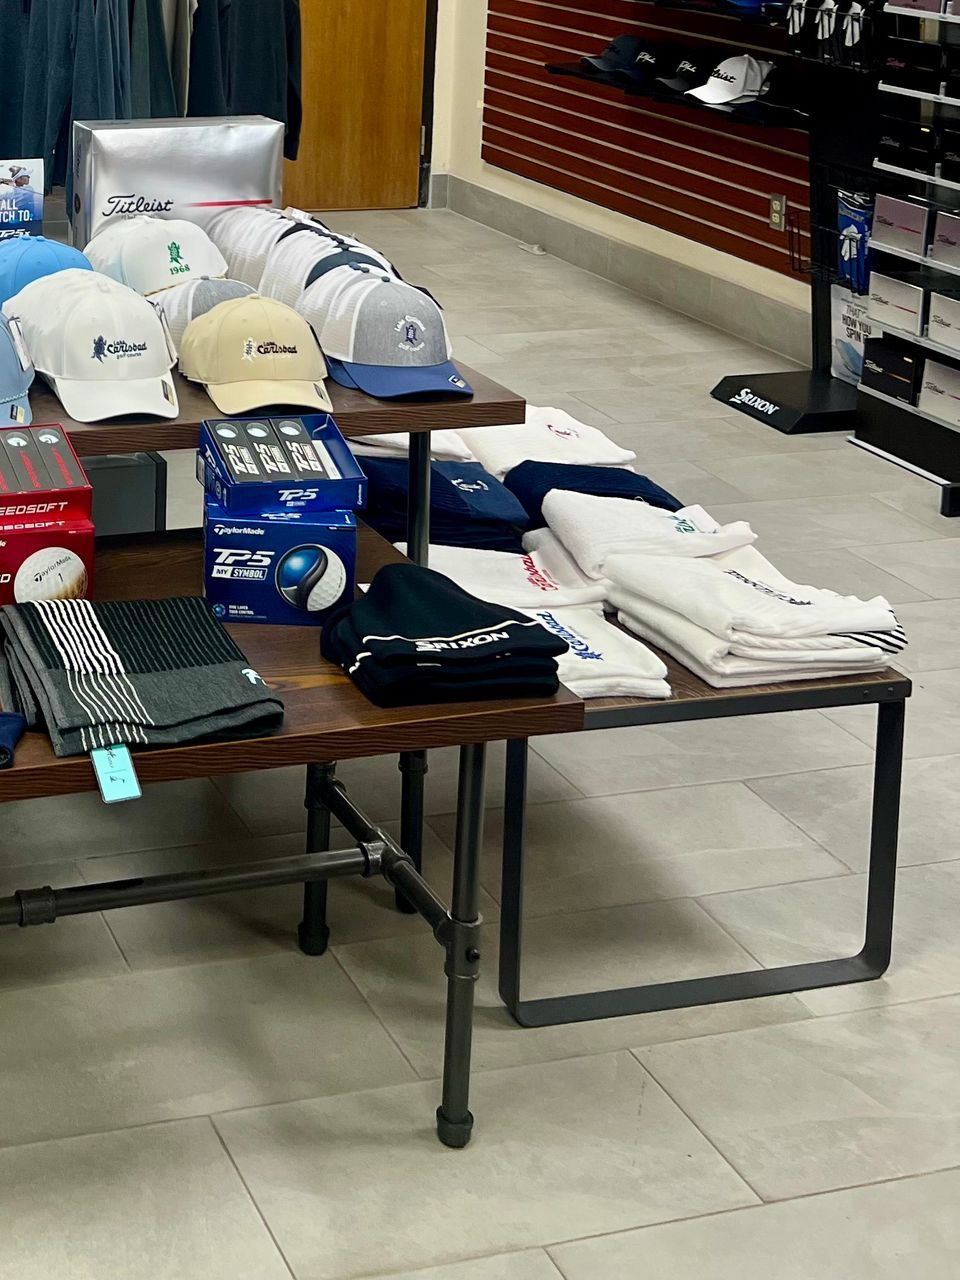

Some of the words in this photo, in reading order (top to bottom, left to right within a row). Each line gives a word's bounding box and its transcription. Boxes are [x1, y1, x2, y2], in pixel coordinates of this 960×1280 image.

[102, 194, 174, 217] Titleist
[17, 209, 33, 222] TO.
[169, 264, 191, 275] 1968
[106, 342, 147, 354] Carlsbad
[257, 343, 298, 354] Carlsbad
[730, 388, 780, 415] SRIXON
[278, 488, 319, 501] TP5
[213, 524, 265, 535] TaylorMade
[212, 548, 275, 566] TP5
[33, 556, 72, 582] TaylorMade
[215, 567, 228, 575] MY
[232, 568, 265, 579] SYMBOL
[57, 572, 64, 583] 1
[416, 631, 510, 652] SRIXON
